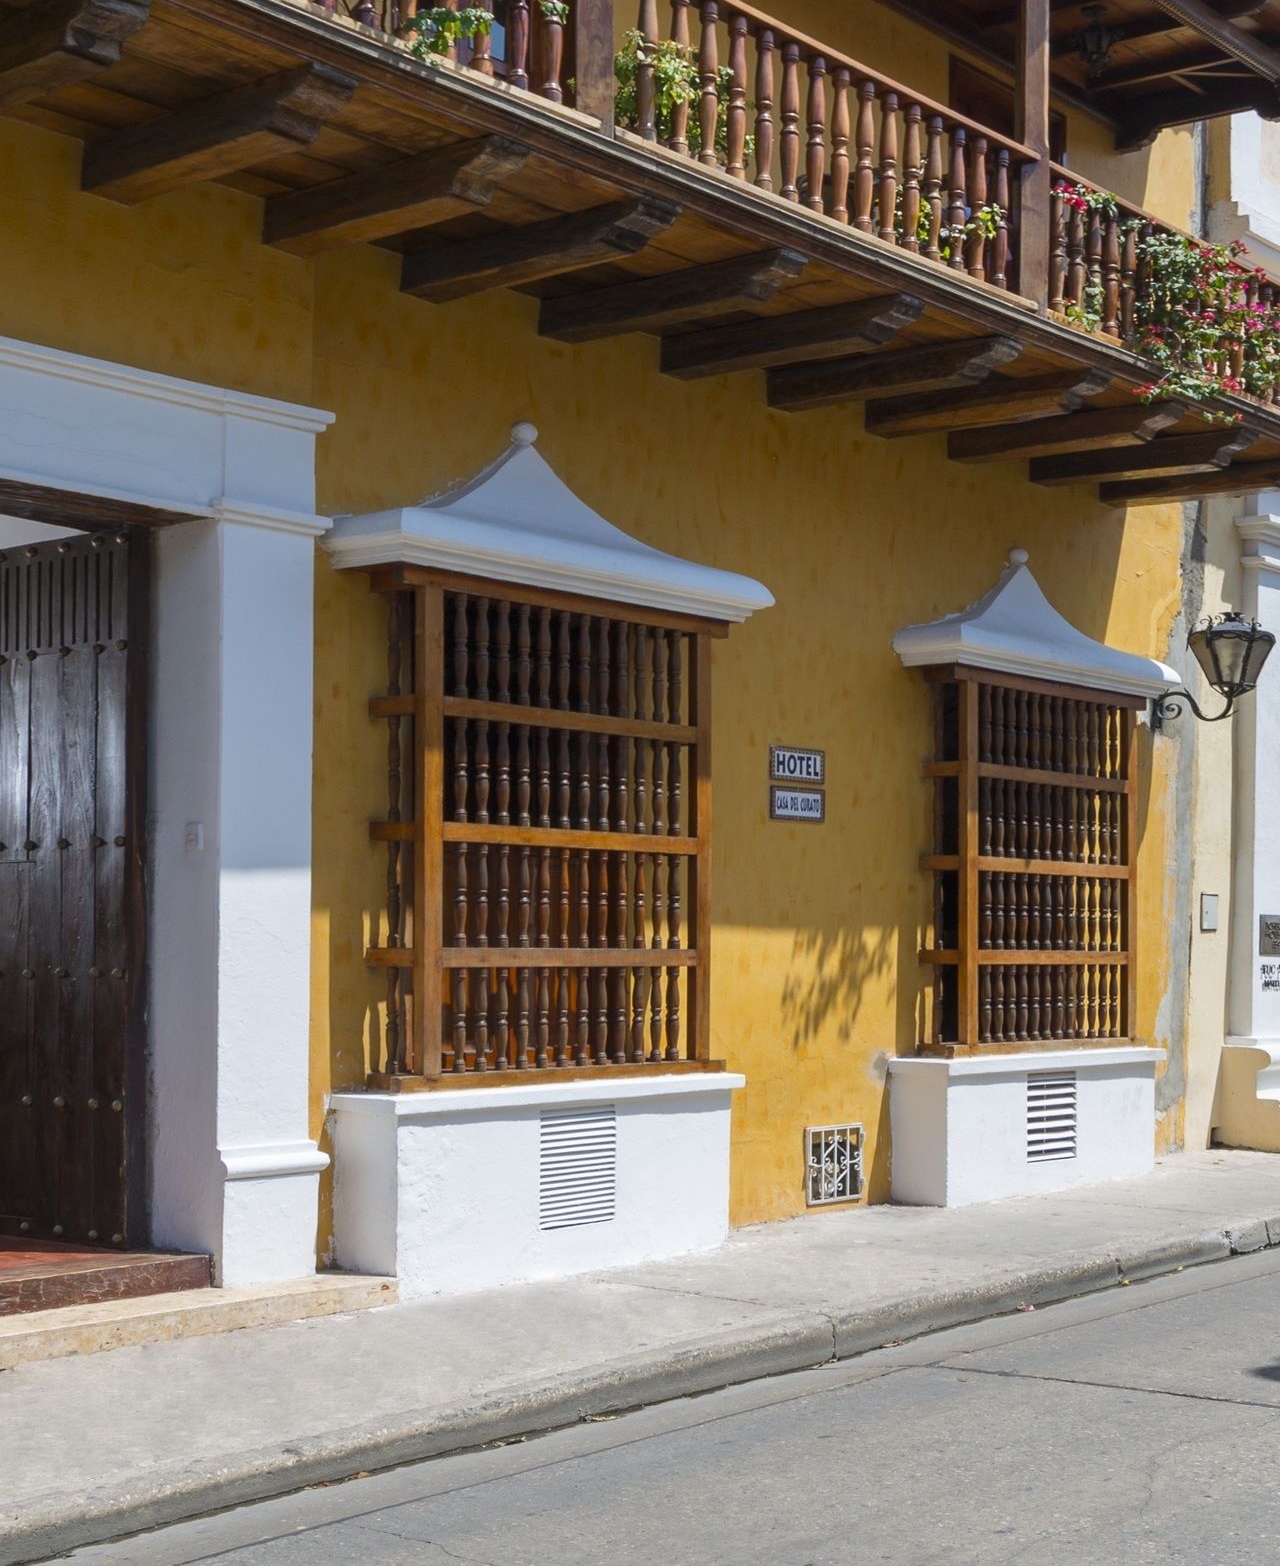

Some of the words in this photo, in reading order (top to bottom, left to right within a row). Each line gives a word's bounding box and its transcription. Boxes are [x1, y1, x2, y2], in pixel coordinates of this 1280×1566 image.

[776, 753, 819, 777] HOTEL
[776, 795, 788, 810] CASA
[790, 796, 799, 811] DEL
